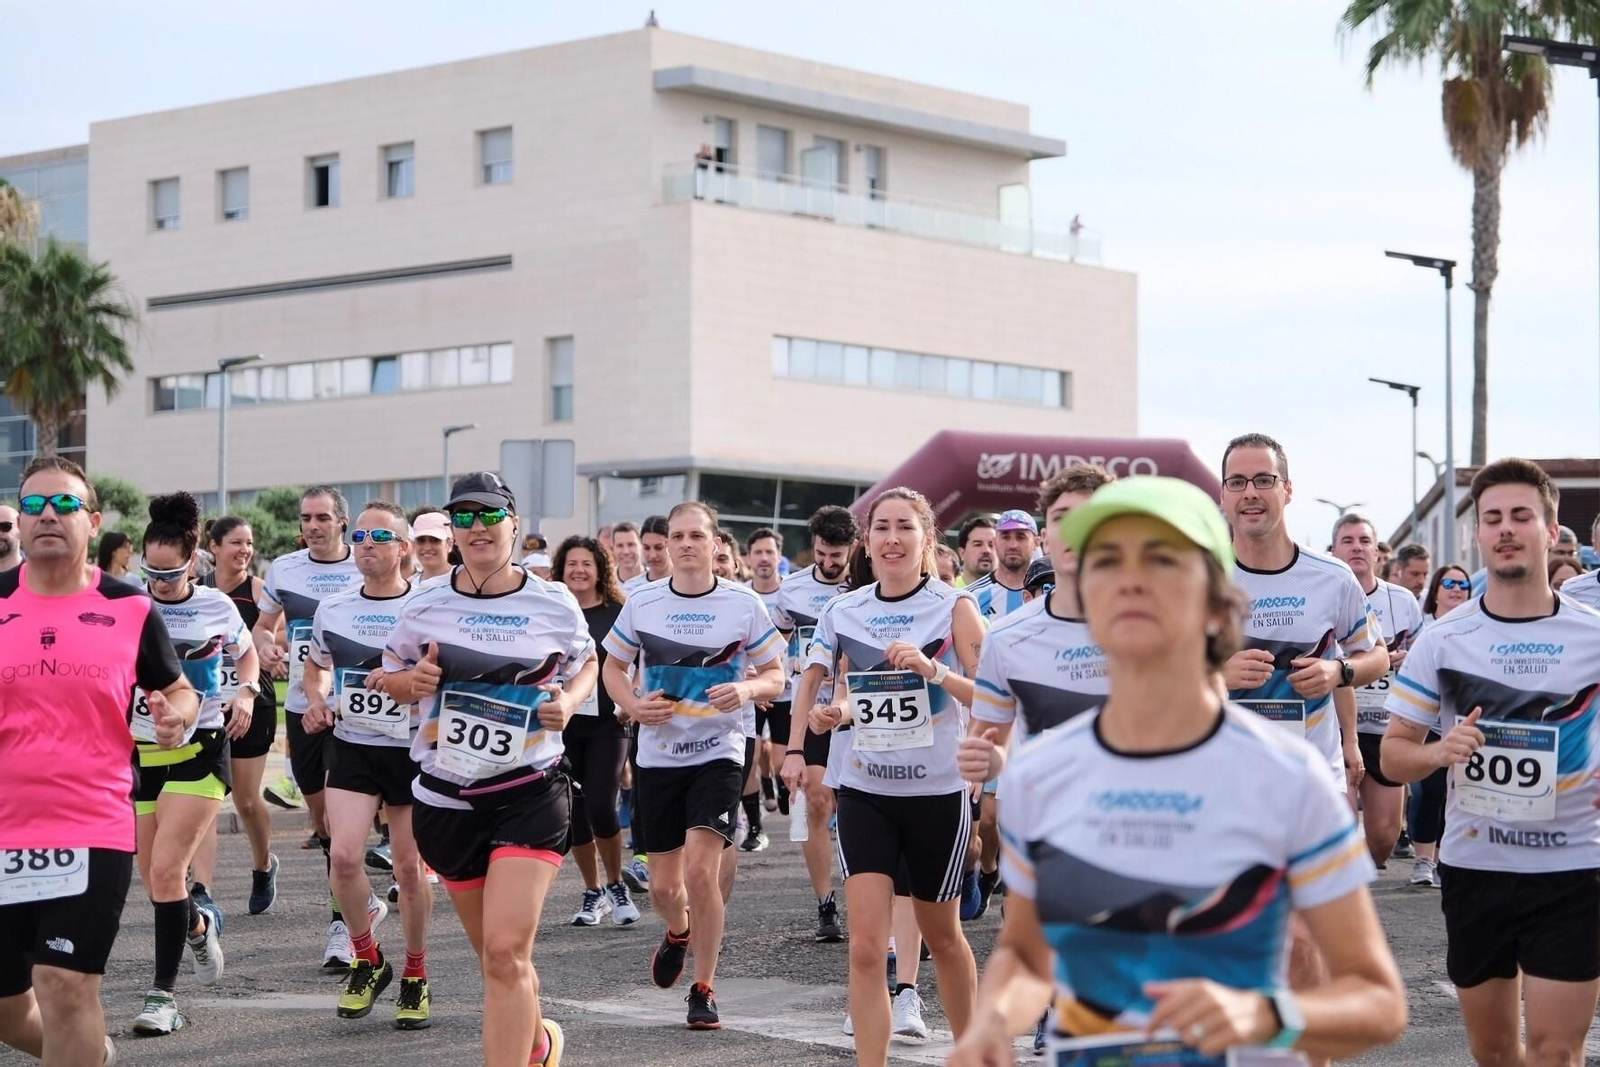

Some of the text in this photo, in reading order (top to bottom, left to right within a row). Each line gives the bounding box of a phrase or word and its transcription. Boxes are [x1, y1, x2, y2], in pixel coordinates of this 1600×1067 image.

[159, 607, 199, 618] ARRERA
[671, 613, 716, 624] CARRERA
[357, 614, 397, 625] CARRER
[465, 615, 530, 628] CARRERA
[1253, 617, 1294, 628] EN SALUD
[471, 633, 516, 643] EN SALUD
[1497, 642, 1564, 656] CARRERA
[1056, 664, 1070, 672] POR
[1070, 668, 1109, 680] EN SAL
[1503, 665, 1548, 675] EN SALUD
[349, 693, 401, 716] 892
[857, 696, 919, 724] 345
[446, 718, 513, 756] 303
[671, 736, 721, 755] IMIBIC
[867, 762, 928, 780] IMIBIC
[1465, 751, 1542, 788] 809
[1488, 826, 1568, 848] IMIBIC
[4, 848, 75, 875] 386
